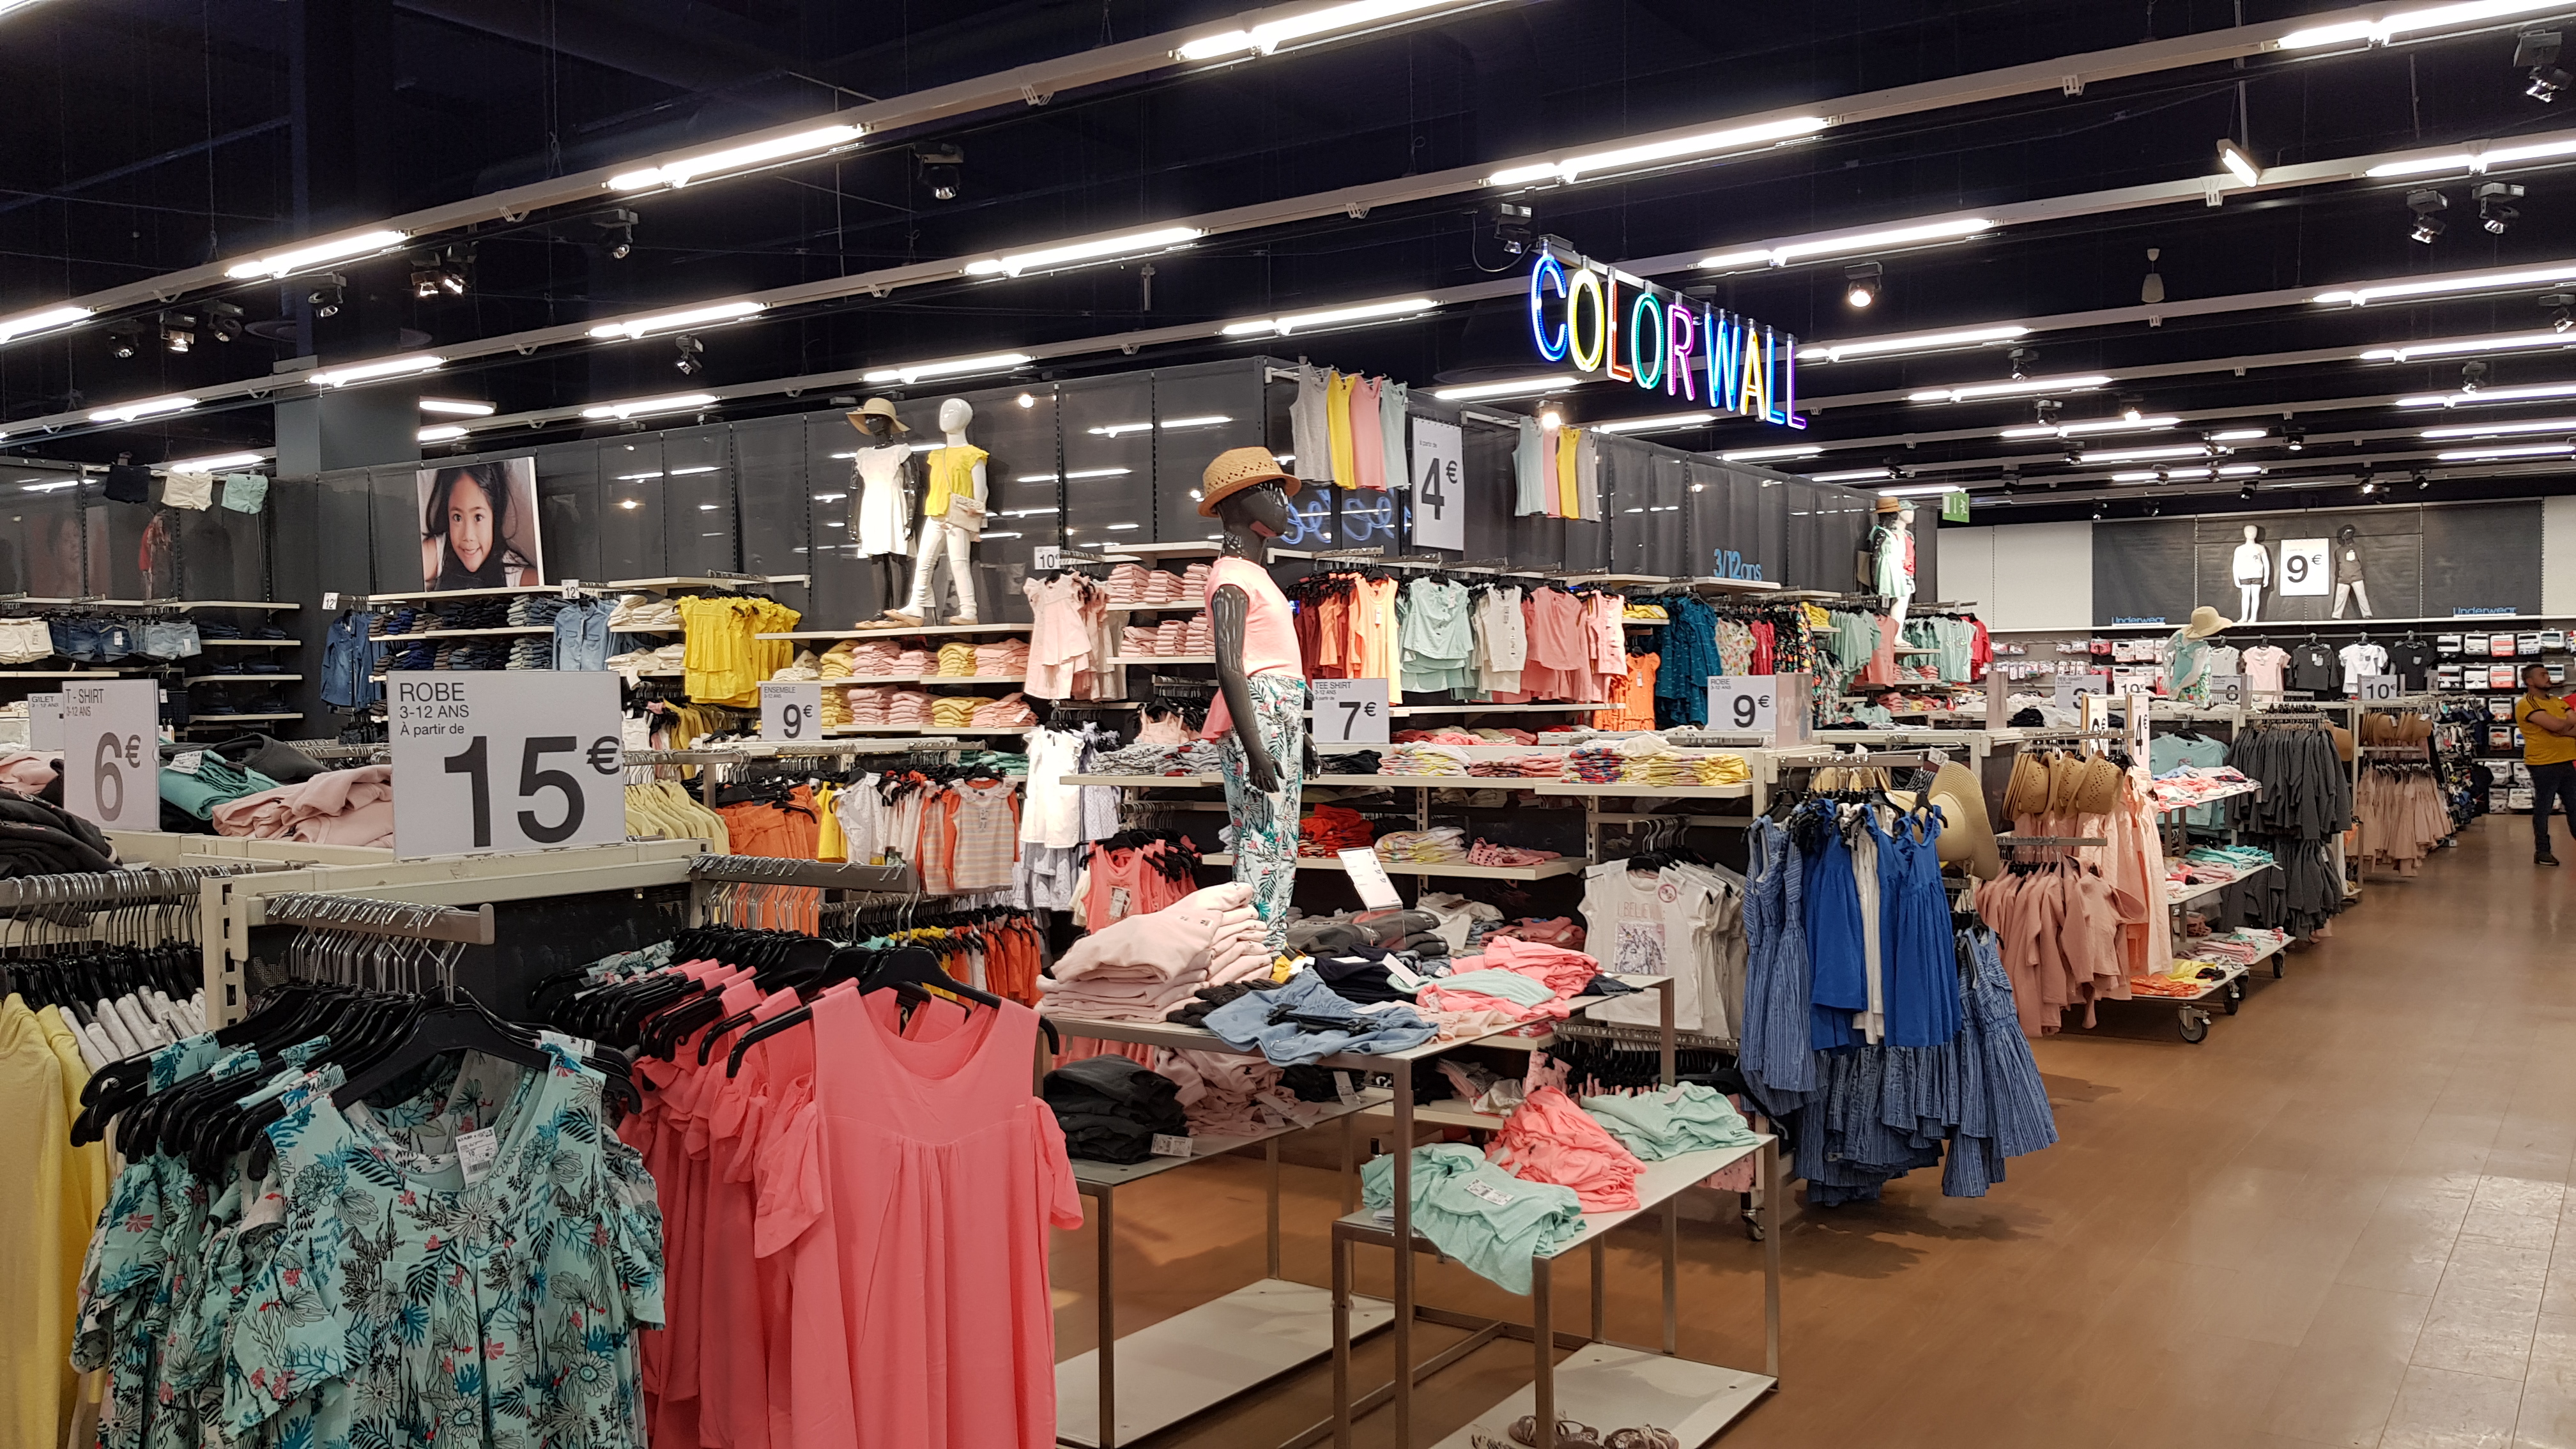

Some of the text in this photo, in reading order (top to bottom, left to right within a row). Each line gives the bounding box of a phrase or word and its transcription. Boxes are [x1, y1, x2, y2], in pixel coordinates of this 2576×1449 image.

[1530, 254, 1807, 431] COLOR WALL
[2453, 607, 2517, 615] Underwear
[2111, 616, 2166, 624] Underwear
[399, 682, 465, 702] ROBE
[66, 706, 91, 716] 3-12 ANS
[399, 705, 470, 719] 3-12 ANS
[401, 721, 464, 737] À partir de
